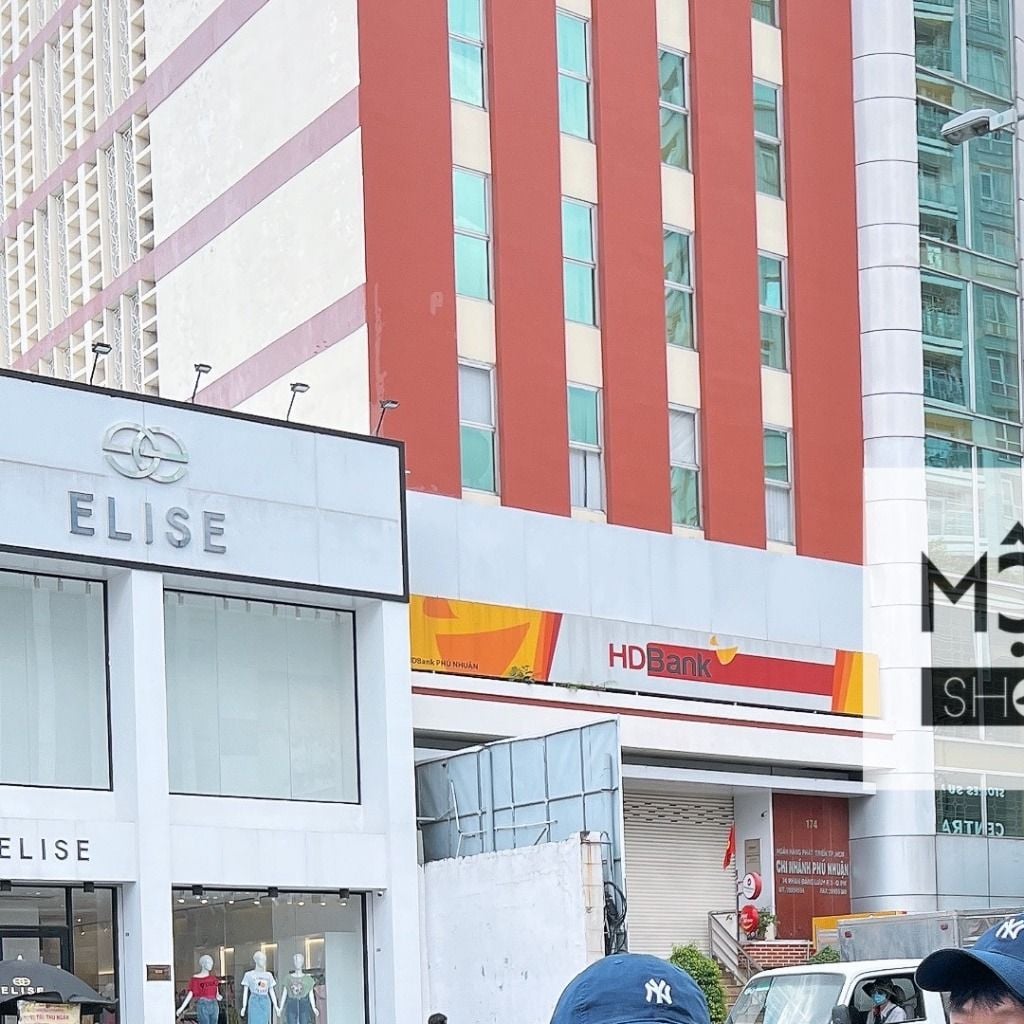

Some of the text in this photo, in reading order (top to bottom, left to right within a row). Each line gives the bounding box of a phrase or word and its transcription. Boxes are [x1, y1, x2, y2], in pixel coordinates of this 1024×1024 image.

[68, 490, 228, 554] ELISE
[411, 656, 434, 666] DBank
[608, 642, 712, 678] HDBank
[0, 837, 90, 862] ELISE
[776, 858, 849, 879] CHI NHÁNH PHÚ NHUẬN
[644, 978, 673, 1005] NY
